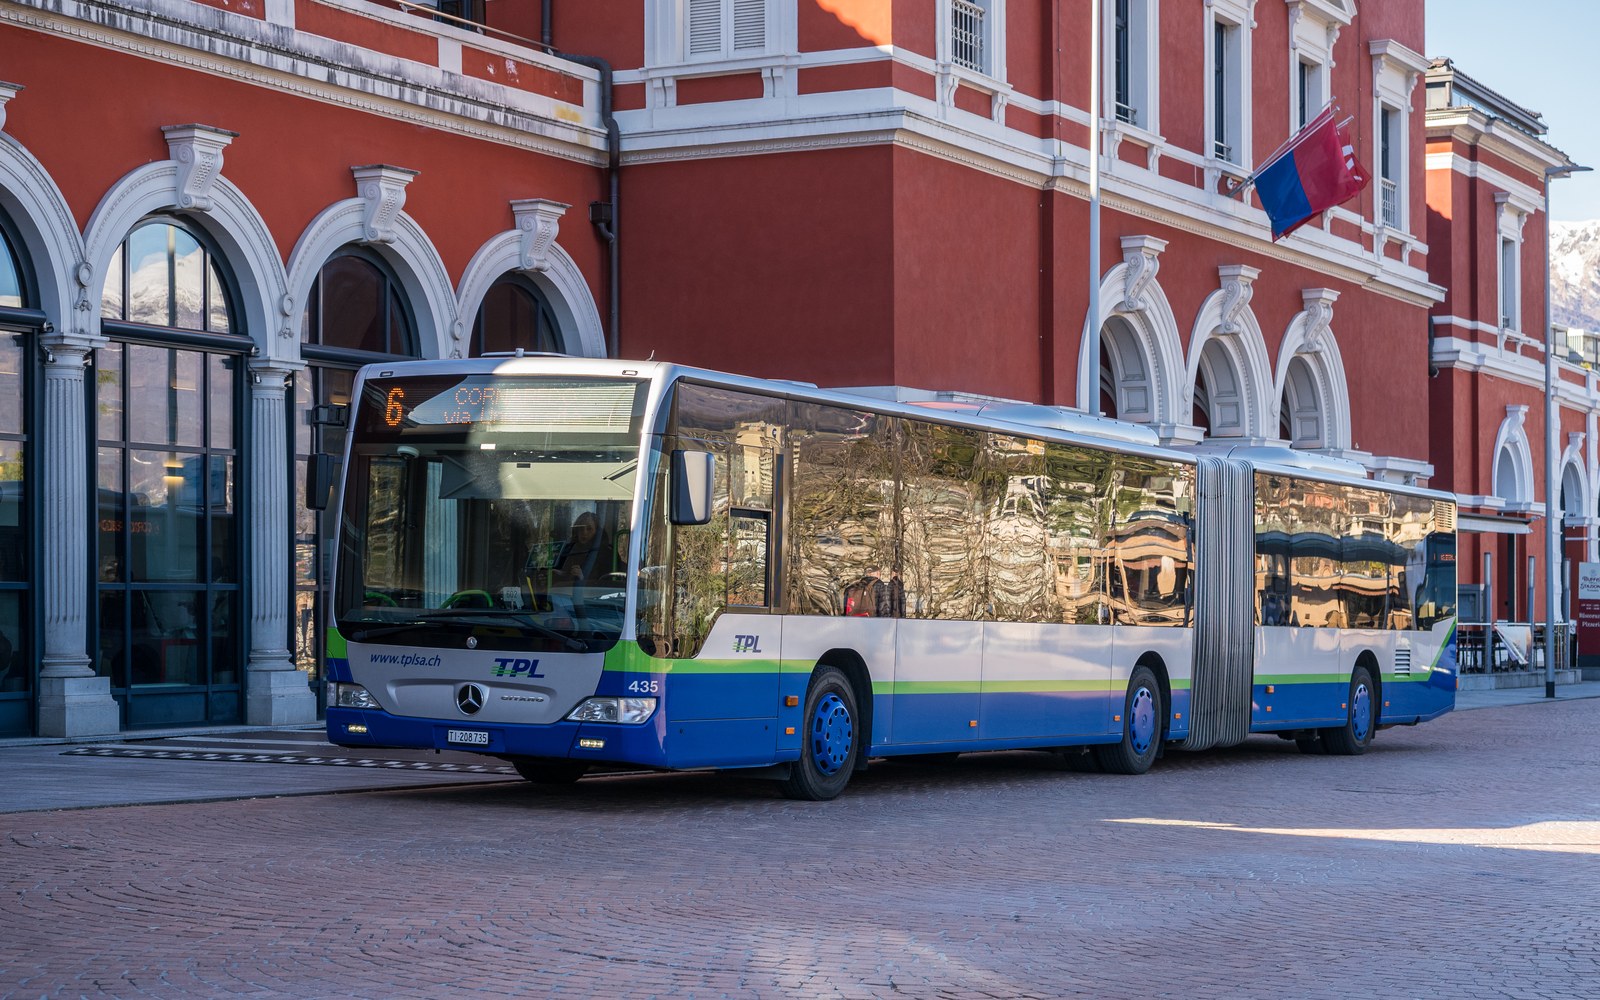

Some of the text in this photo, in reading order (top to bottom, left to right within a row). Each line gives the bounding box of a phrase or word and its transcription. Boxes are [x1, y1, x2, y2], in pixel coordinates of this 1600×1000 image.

[386, 387, 404, 426] 6
[444, 407, 471, 424] via
[733, 634, 762, 653] TPL
[370, 653, 441, 667] www.tplsa.ch
[493, 657, 546, 679] TPL
[628, 680, 659, 693] 435
